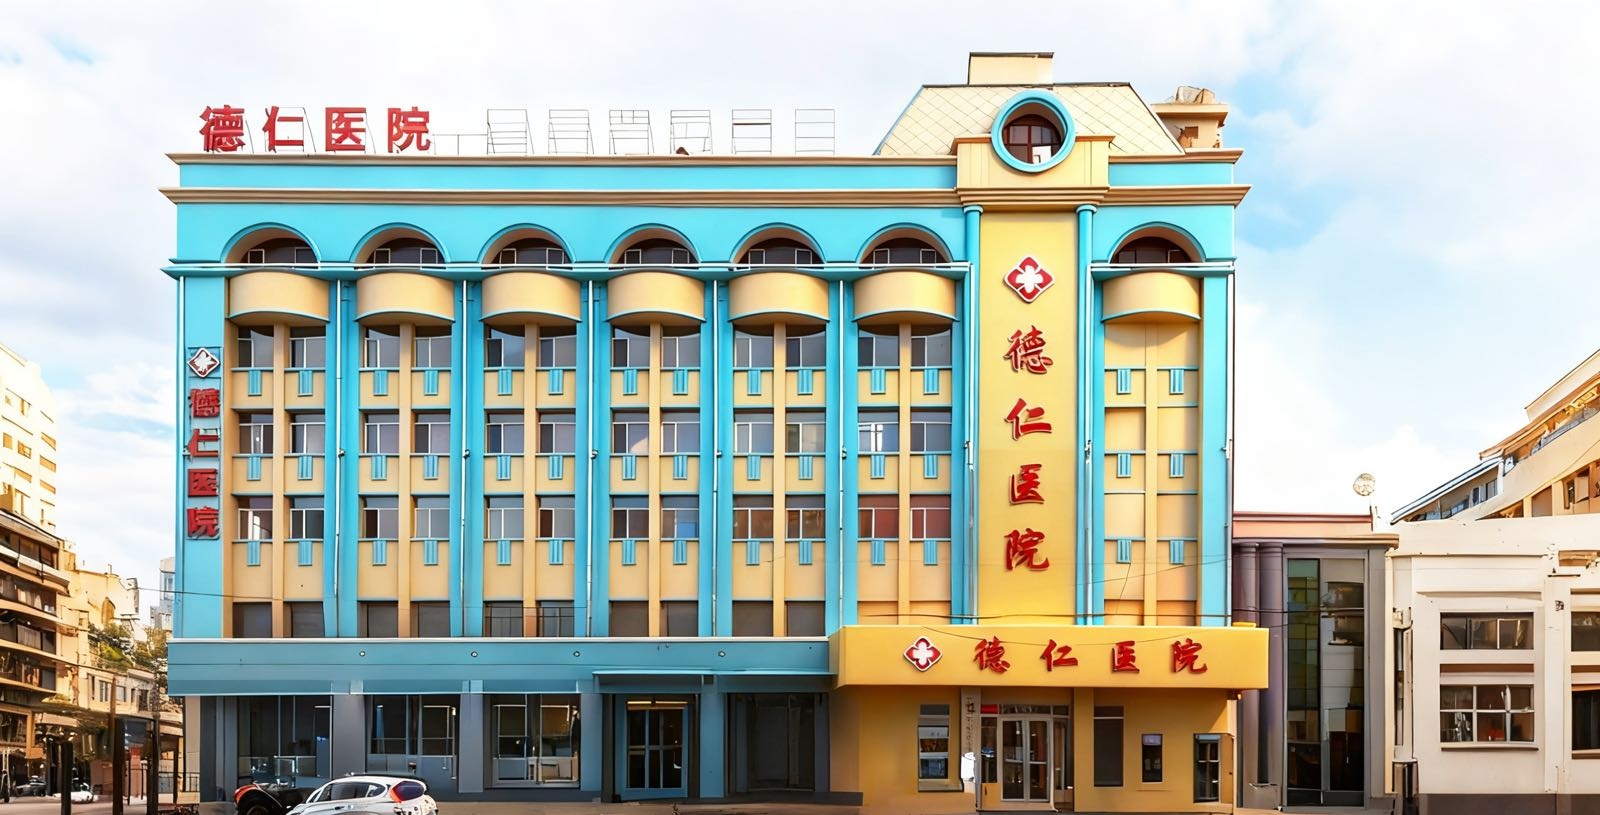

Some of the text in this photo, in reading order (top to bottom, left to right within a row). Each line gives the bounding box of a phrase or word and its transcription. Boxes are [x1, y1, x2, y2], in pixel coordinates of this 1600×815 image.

[199, 105, 431, 153] 德仁医院
[187, 387, 220, 538] 德仁医院
[1003, 325, 1053, 571] 德仁医院
[974, 636, 1208, 673] 德仁医院
